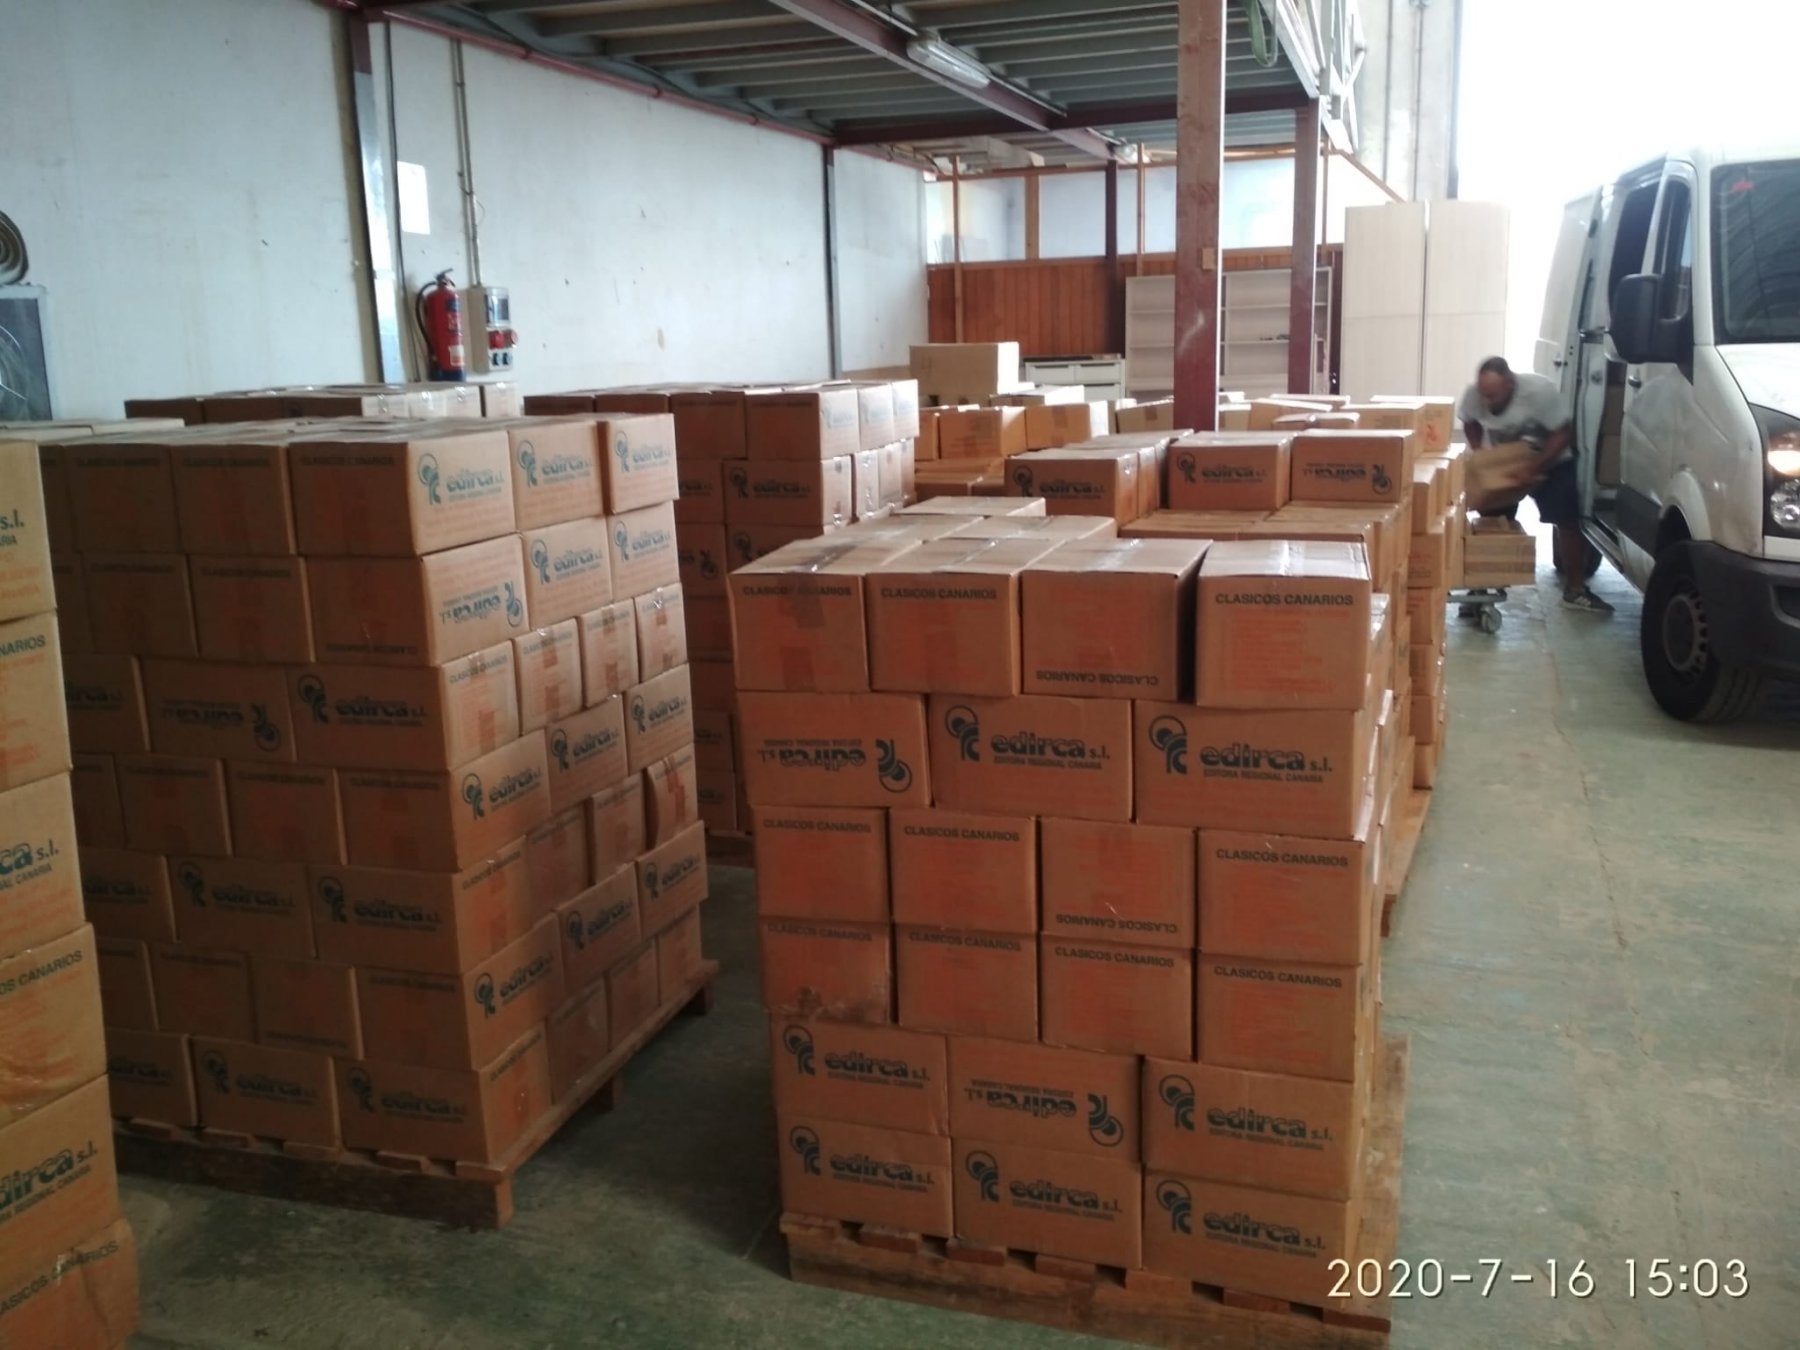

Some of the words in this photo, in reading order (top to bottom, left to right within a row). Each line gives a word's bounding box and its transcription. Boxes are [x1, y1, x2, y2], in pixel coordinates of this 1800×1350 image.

[797, 586, 851, 597] ARIOS
[882, 588, 936, 599] CLASICOS
[940, 588, 997, 600] CANARIOS
[1216, 594, 1281, 606] CLASICOS
[1285, 594, 1354, 606] CANARIOS
[0, 634, 46, 656] NARIOS
[1036, 670, 1096, 683] CANARIOS
[1100, 673, 1158, 686] CLASICOS
[991, 731, 1086, 758] edirca
[1089, 746, 1110, 760] s.l.
[779, 748, 867, 771] edirca
[1201, 742, 1306, 771] edirca
[1310, 757, 1333, 772] s.l.
[763, 819, 815, 831] CLASICOS
[817, 821, 871, 833] CANARIOS
[904, 825, 960, 838] CLASICOS
[962, 829, 1019, 842] CANARIOS
[36, 839, 59, 861] s.l.
[1216, 849, 1279, 864] CLASICOS
[1281, 852, 1348, 868] CANARIOS
[1056, 914, 1116, 928] CANARIOS
[1119, 919, 1177, 934] CLASICOS
[909, 931, 962, 946] CLASICOS
[965, 937, 1021, 951] CANARIOS
[18, 950, 83, 986] CANARIOS
[1055, 946, 1112, 961] CLASICOS
[1115, 952, 1174, 968] CANARIOS
[1214, 965, 1275, 982] CLASICOS
[1278, 972, 1342, 988] CANARIOS
[825, 1051, 909, 1078] edirca
[986, 1090, 1077, 1119] edirca
[1207, 1107, 1307, 1138] edirca
[1311, 1127, 1333, 1141] s.l.
[76, 1140, 98, 1163] s.l.
[830, 1153, 914, 1181] edirca
[1010, 1179, 1100, 1210] edirca
[1204, 1211, 1301, 1244] edirca
[0, 1275, 48, 1315] ASICOS
